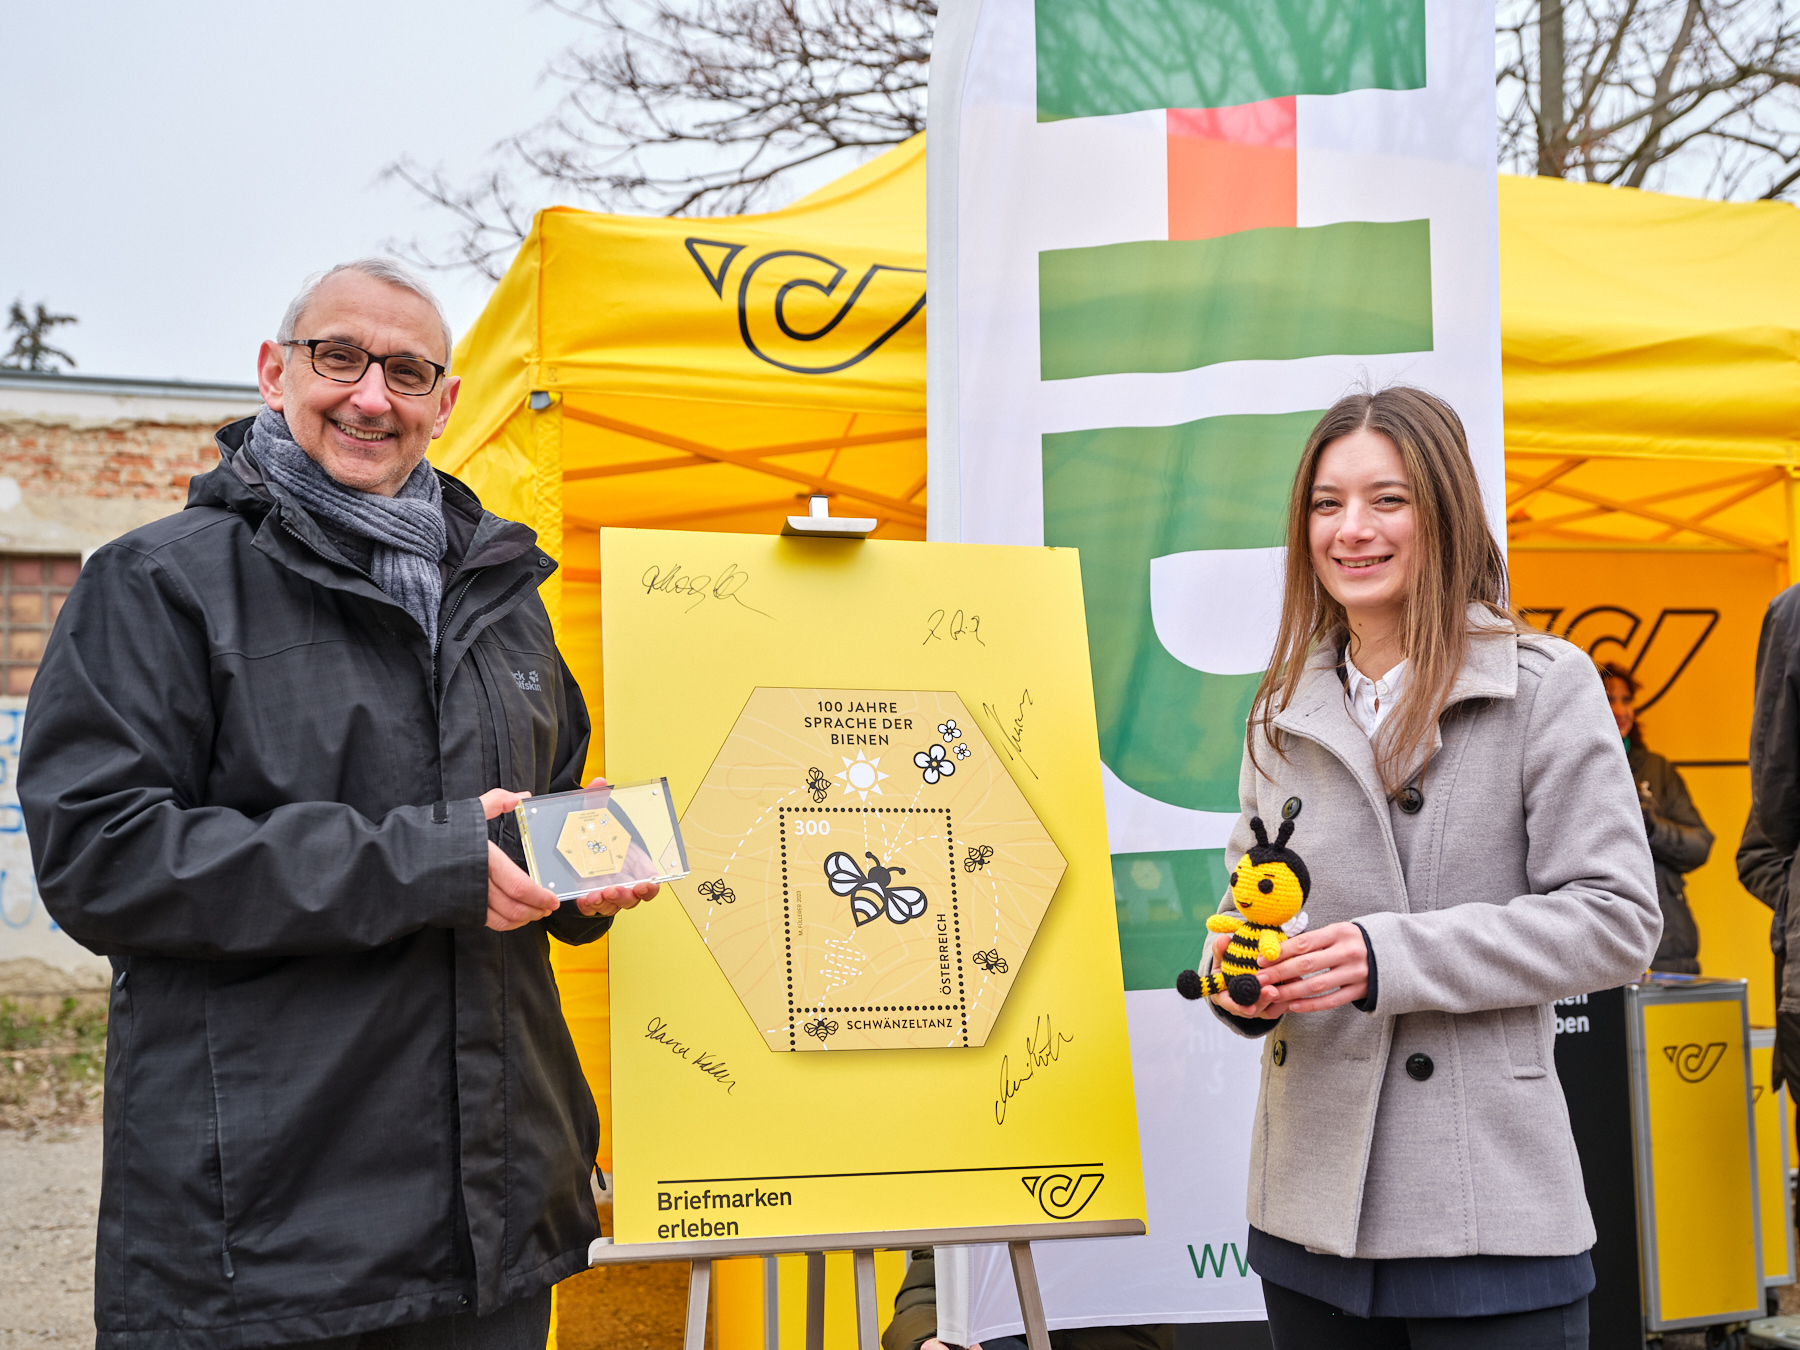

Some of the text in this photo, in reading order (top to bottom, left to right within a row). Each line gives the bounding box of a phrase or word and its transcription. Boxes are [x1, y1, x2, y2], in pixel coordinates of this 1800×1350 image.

[818, 701, 898, 713] 100 JAHRE
[804, 716, 913, 730] SPRACHE DER
[831, 733, 889, 746] BIENEN
[794, 819, 831, 836] 300
[936, 913, 952, 995] ÖSTERREICH
[846, 1017, 953, 1030] SCHWÄNZELTANZ
[657, 1188, 792, 1211] Briefmarken
[657, 1218, 739, 1239] erleben
